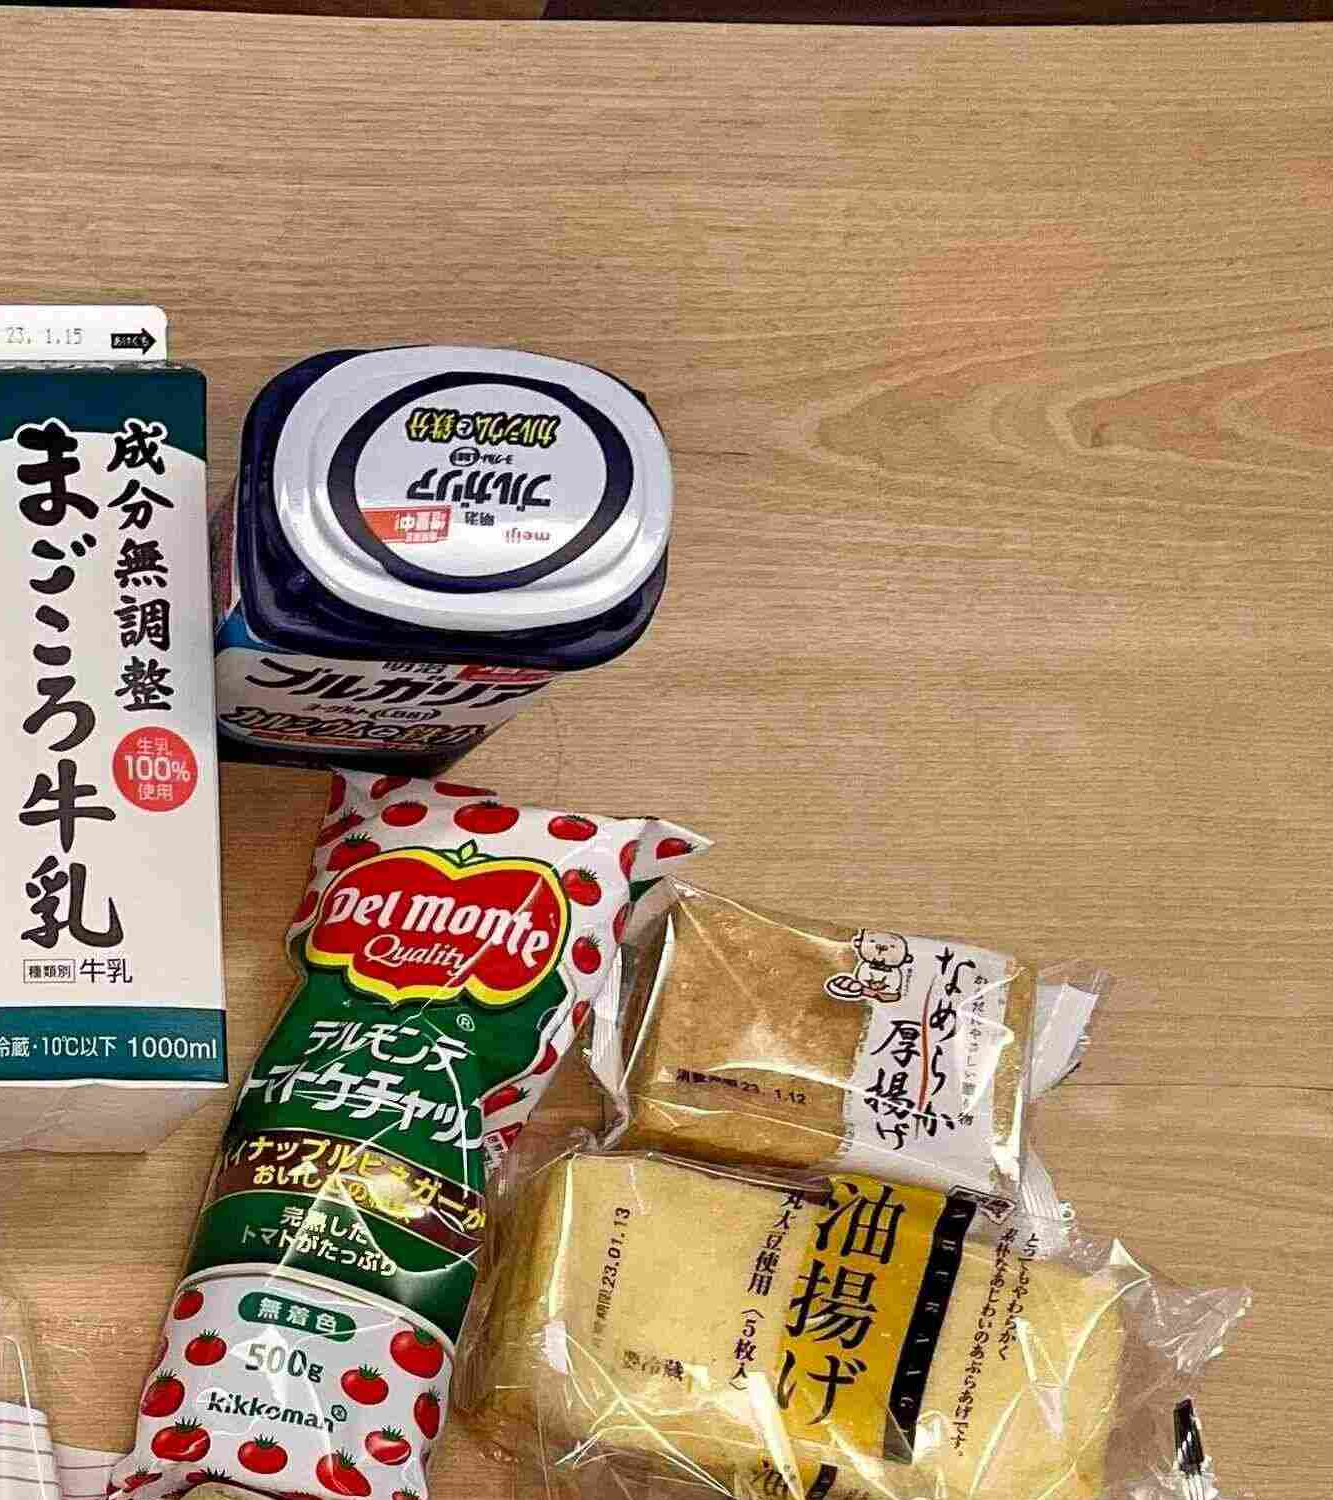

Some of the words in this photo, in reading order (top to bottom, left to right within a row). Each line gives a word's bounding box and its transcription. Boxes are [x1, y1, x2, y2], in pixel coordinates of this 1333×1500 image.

[407, 409, 560, 447] カルシウムと鉄分
[406, 468, 551, 511] ブルガリア
[465, 512, 495, 526] 明治
[504, 528, 550, 543] meiji
[107, 422, 175, 711] 成分無調整
[17, 420, 124, 949] まごころ牛乳
[245, 657, 553, 708] ブルガリア
[137, 737, 172, 757] 生乳
[124, 756, 191, 783] 100%
[138, 783, 173, 801] 使用
[327, 886, 402, 928] Del
[401, 896, 550, 967] Monte
[28, 964, 72, 979] 種類別
[79, 958, 133, 984] 牛乳
[365, 933, 477, 979] Quality
[128, 1036, 216, 1059] 1000ml
[303, 1020, 469, 1071] デルモンテ
[913, 946, 976, 1139] なめらか
[863, 1020, 920, 1151] 厚揚げ
[282, 1206, 369, 1245] 完熟した
[747, 1191, 805, 1296] 丸大豆使用
[242, 1224, 398, 1277] トマトがたっぷり
[258, 1296, 339, 1332] 無着色
[776, 1182, 906, 1427] 油揚げ
[245, 1342, 323, 1383] 500g
[208, 1391, 334, 1434] kikkoman
